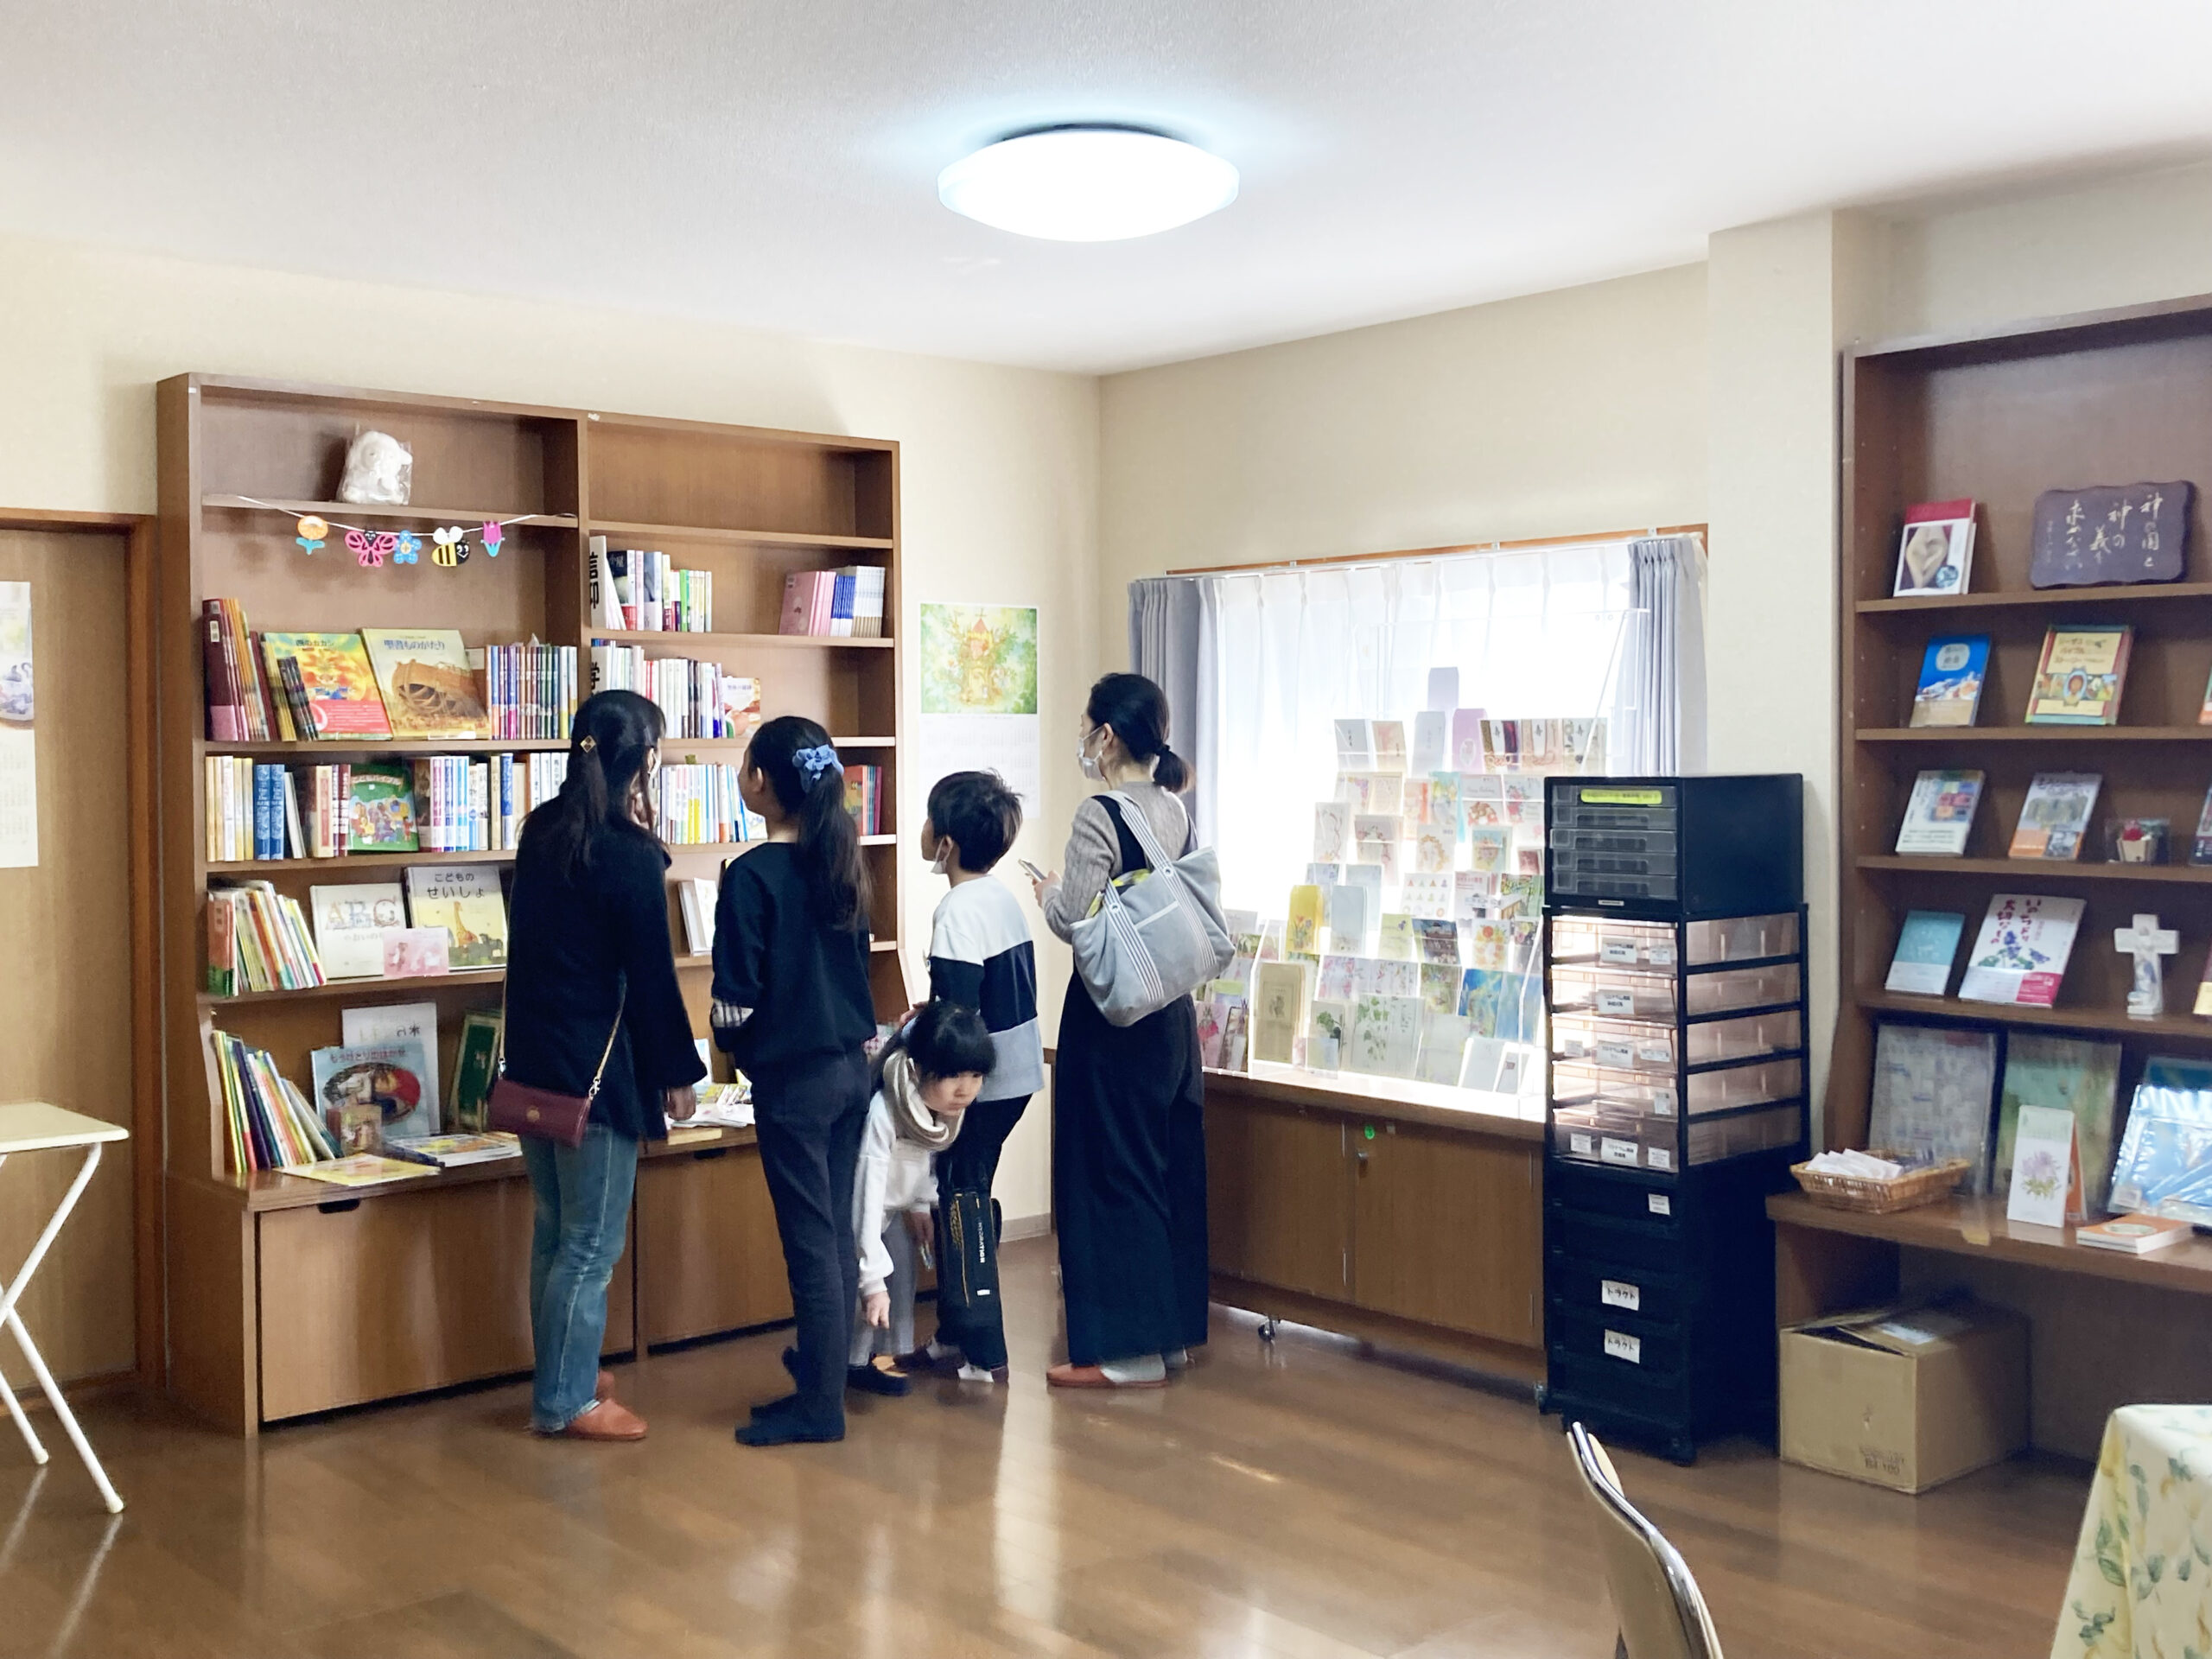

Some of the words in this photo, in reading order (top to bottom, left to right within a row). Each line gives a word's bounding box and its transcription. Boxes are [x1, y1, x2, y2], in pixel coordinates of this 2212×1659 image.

[435, 872, 475, 882] こどもの
[427, 886, 485, 899] せいしょ
